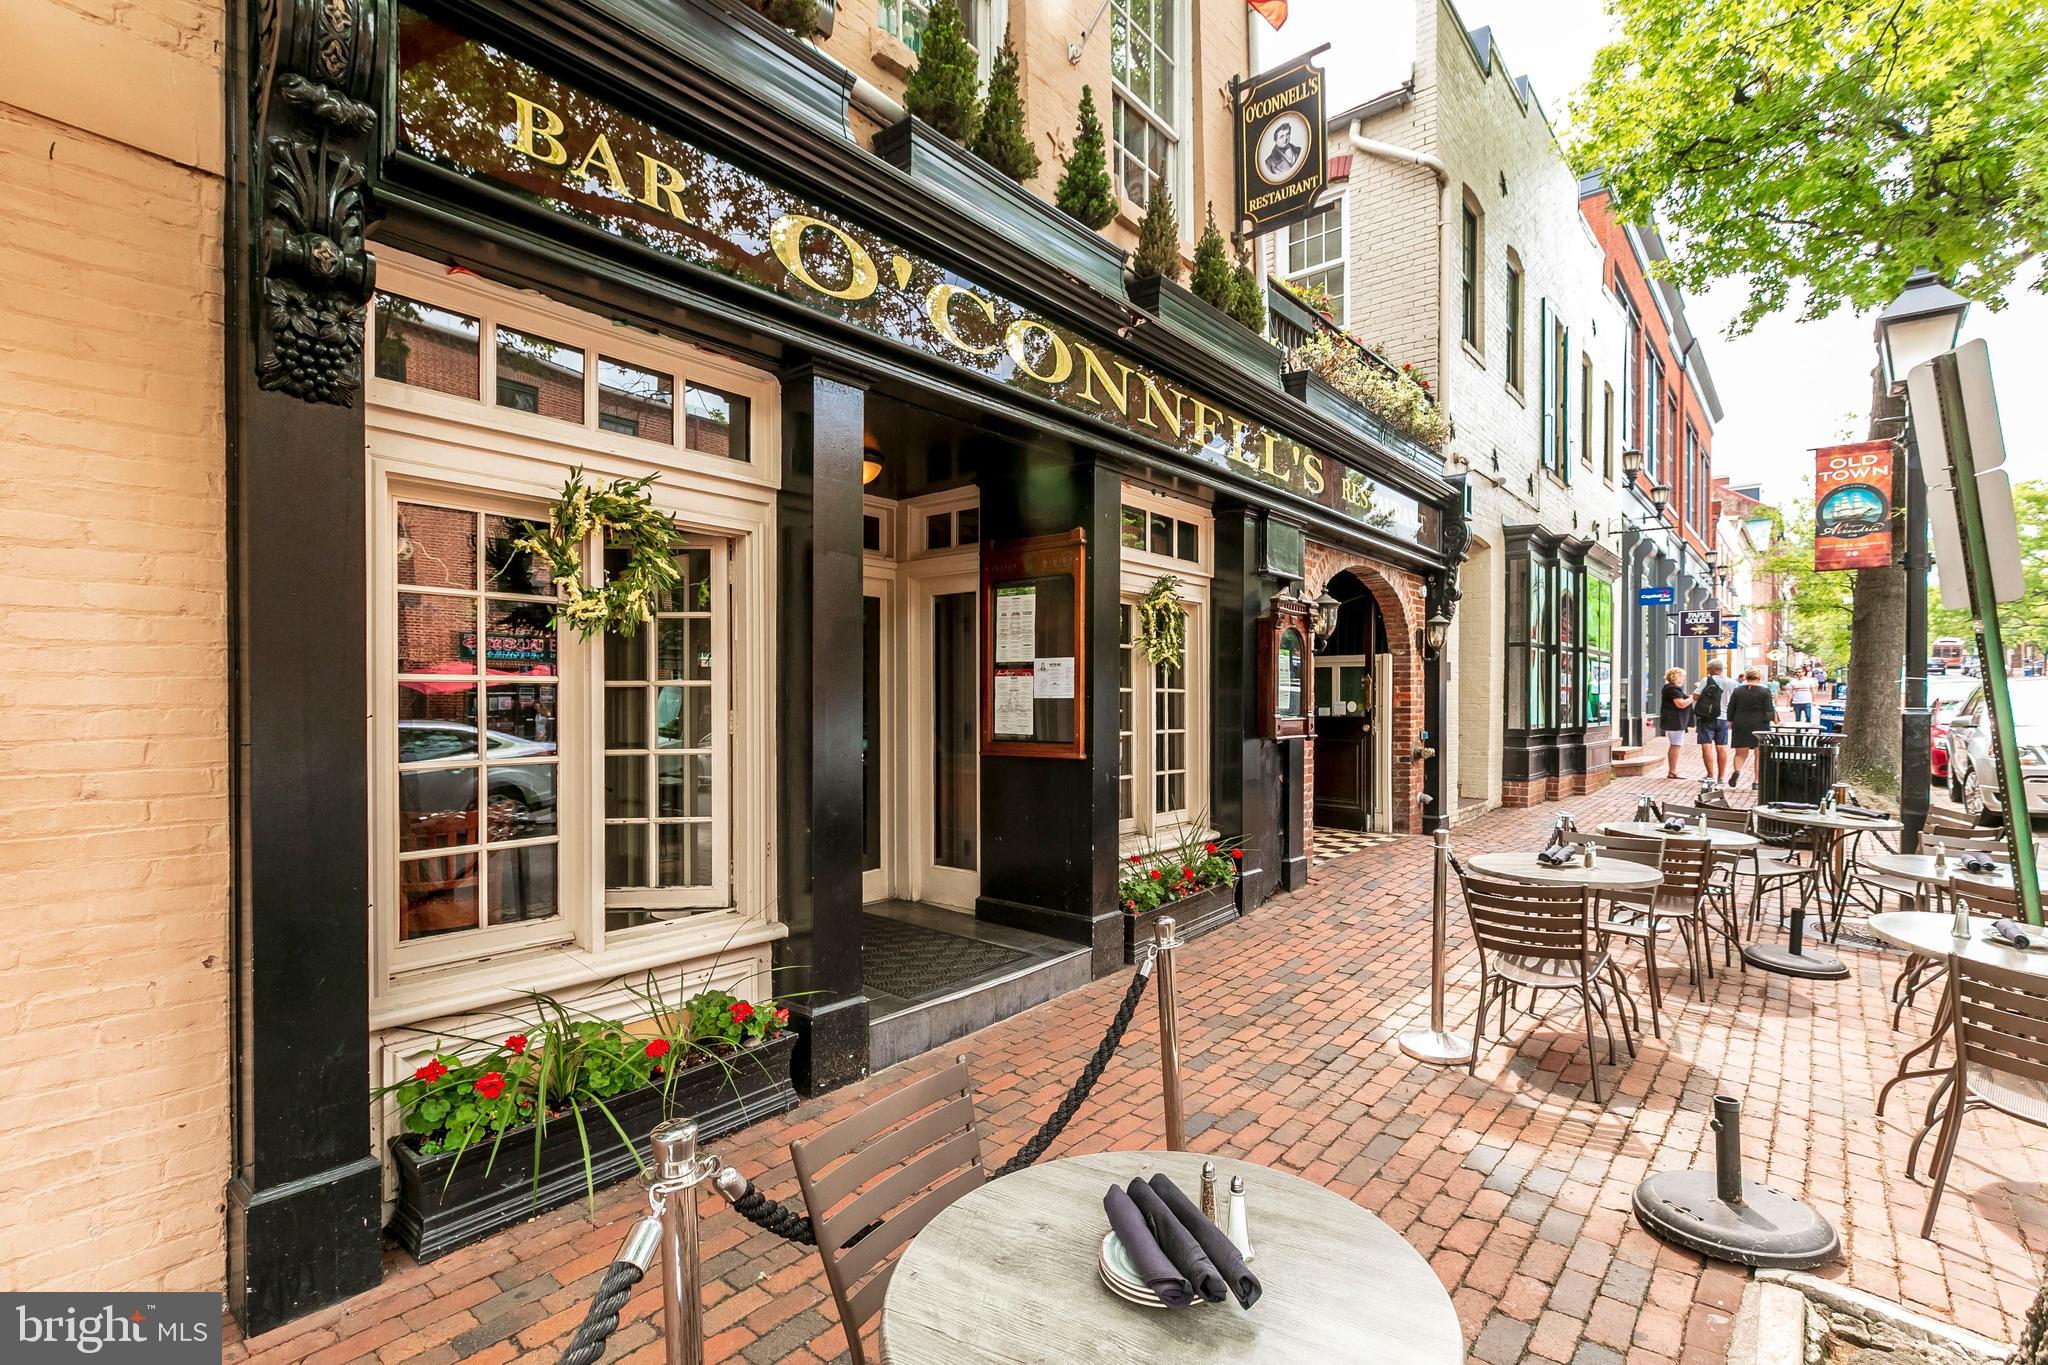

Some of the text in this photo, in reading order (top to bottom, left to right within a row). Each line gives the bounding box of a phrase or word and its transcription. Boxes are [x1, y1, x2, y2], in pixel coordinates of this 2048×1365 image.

[1246, 77, 1319, 123] O'CONNELL'S
[1249, 175, 1319, 213] RESTAURANT
[507, 92, 695, 224] BAR
[770, 213, 1327, 495] O'CONNELL'S
[1819, 465, 1889, 482] TOWN
[1829, 454, 1879, 469] OLD
[1687, 611, 1713, 619] PAPER
